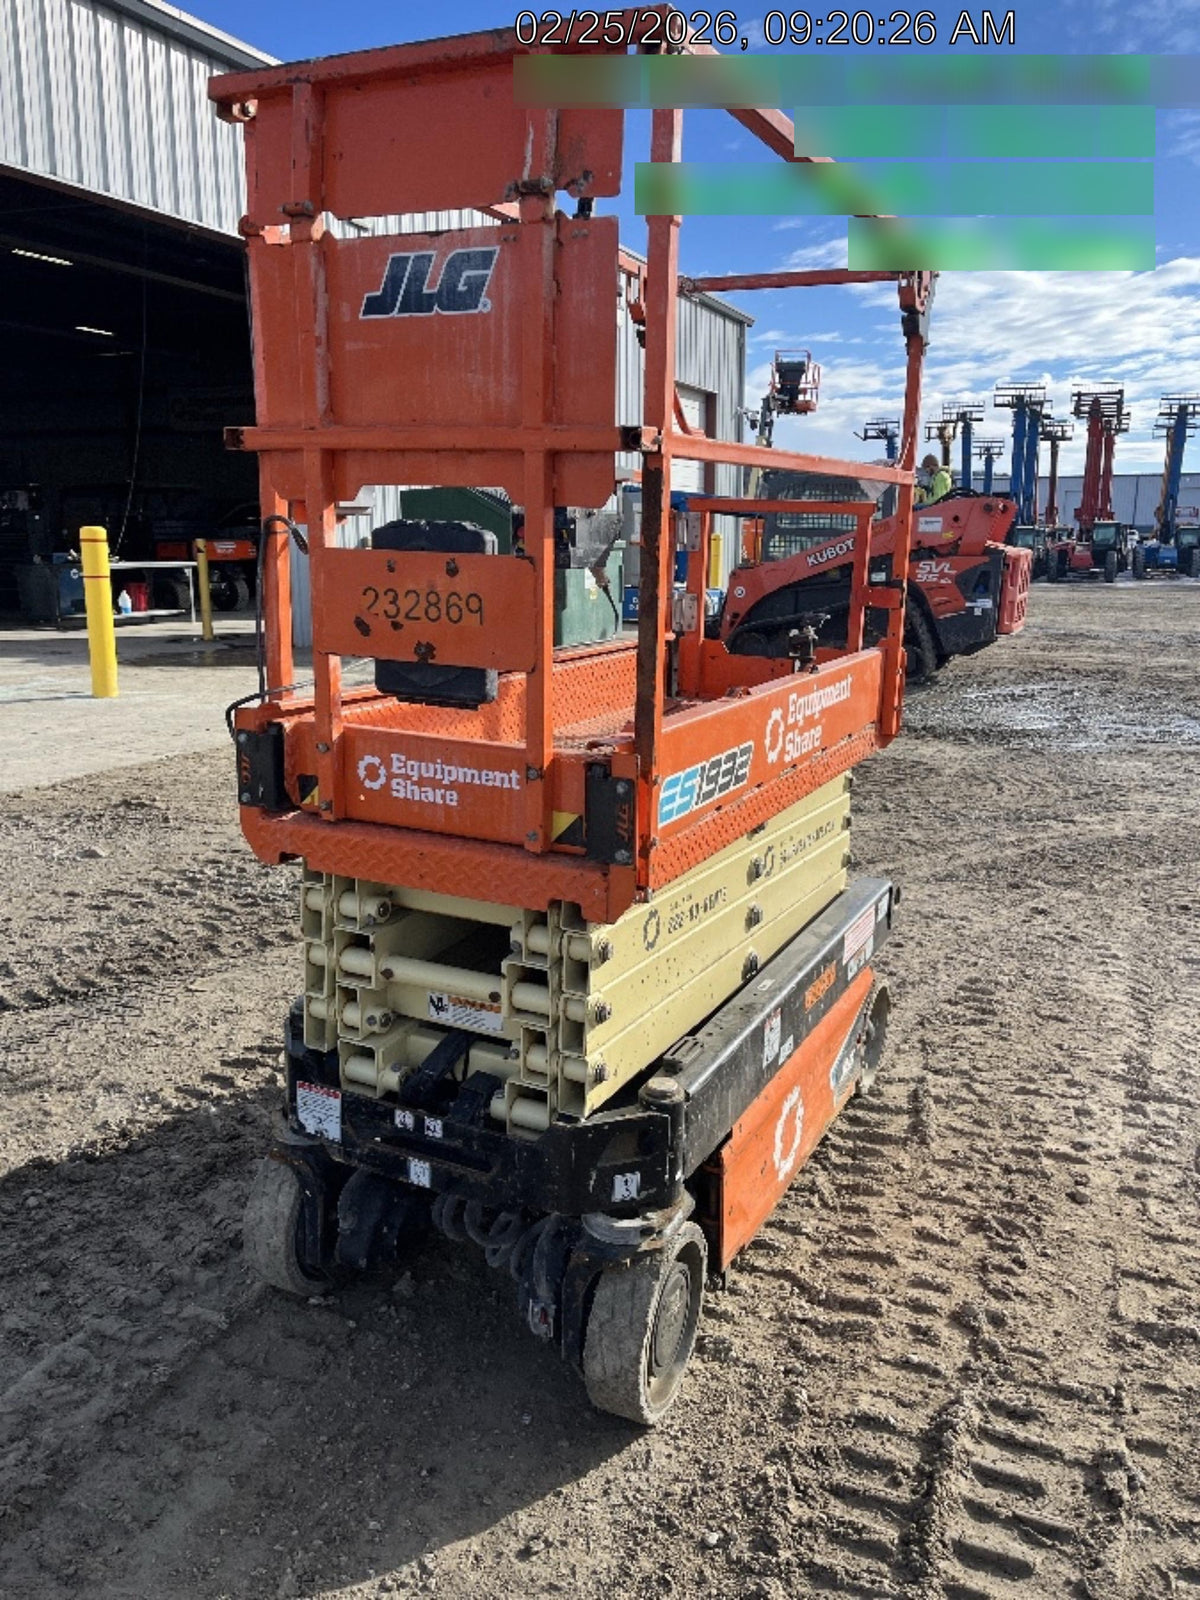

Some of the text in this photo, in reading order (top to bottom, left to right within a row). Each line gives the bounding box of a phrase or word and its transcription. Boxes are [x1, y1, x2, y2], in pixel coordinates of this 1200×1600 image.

[359, 246, 500, 319] JLG
[806, 538, 856, 568] KUBOT
[915, 561, 957, 574] SVL
[362, 586, 484, 626] 232869
[786, 673, 853, 727] Equipment
[784, 725, 822, 763] Share
[390, 753, 521, 790] Equipment
[390, 779, 459, 806] Share
